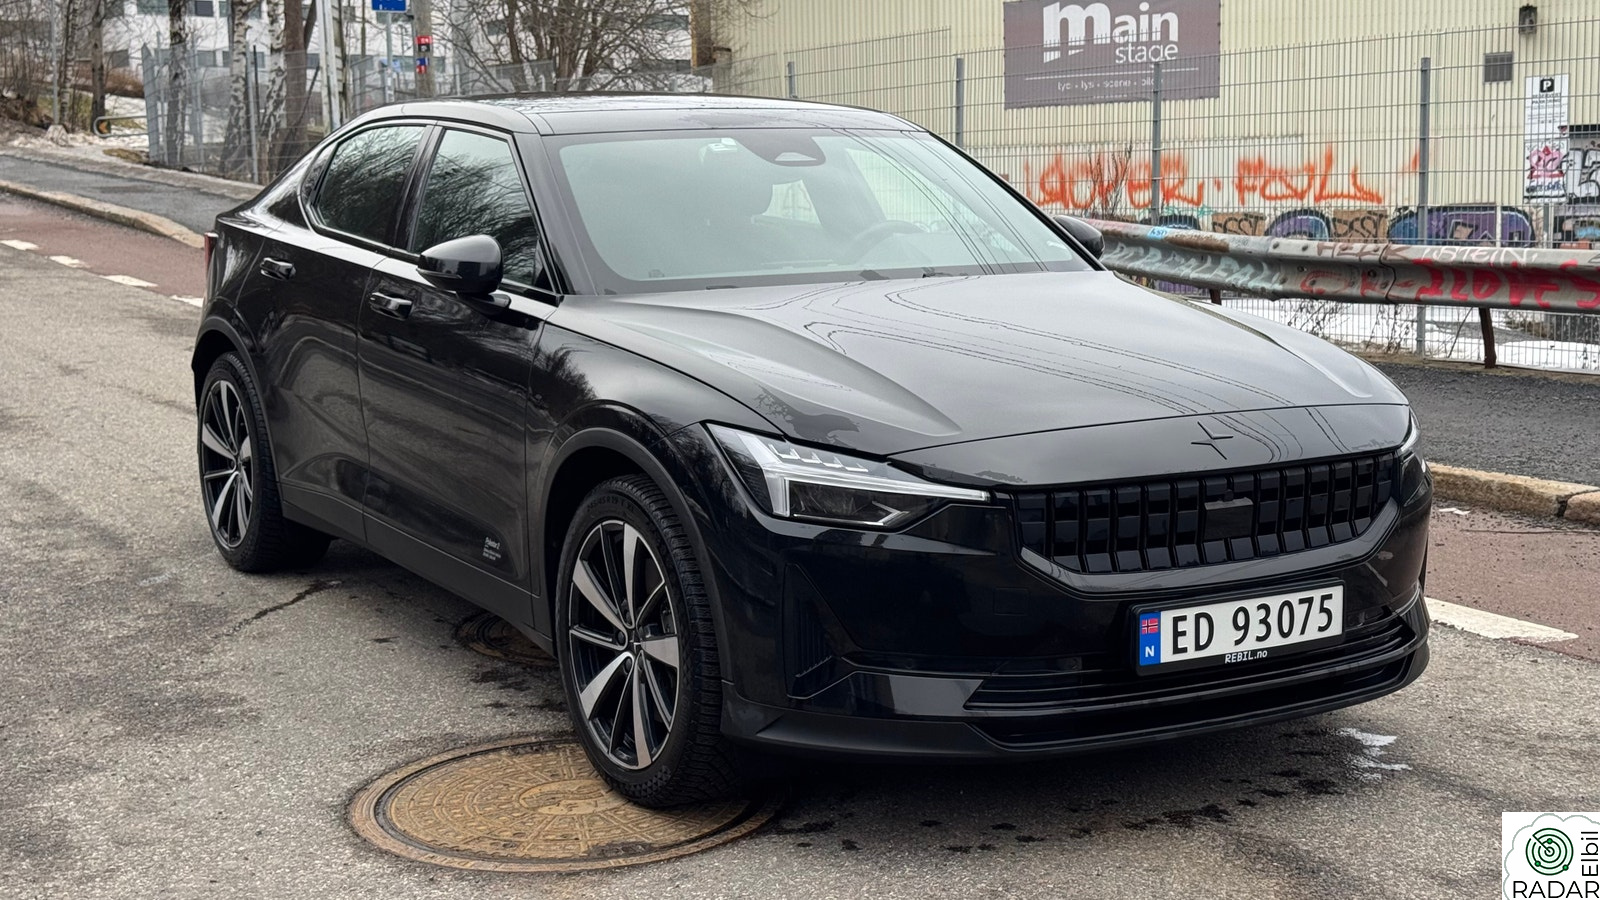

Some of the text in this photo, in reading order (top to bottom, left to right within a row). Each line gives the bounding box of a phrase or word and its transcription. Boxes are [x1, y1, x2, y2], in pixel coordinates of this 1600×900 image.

[1043, 2, 1179, 63] main
[1115, 43, 1178, 69] stage
[1172, 593, 1333, 655] ED 93075
[1145, 646, 1155, 658] N
[1224, 650, 1268, 664] REBIL.no
